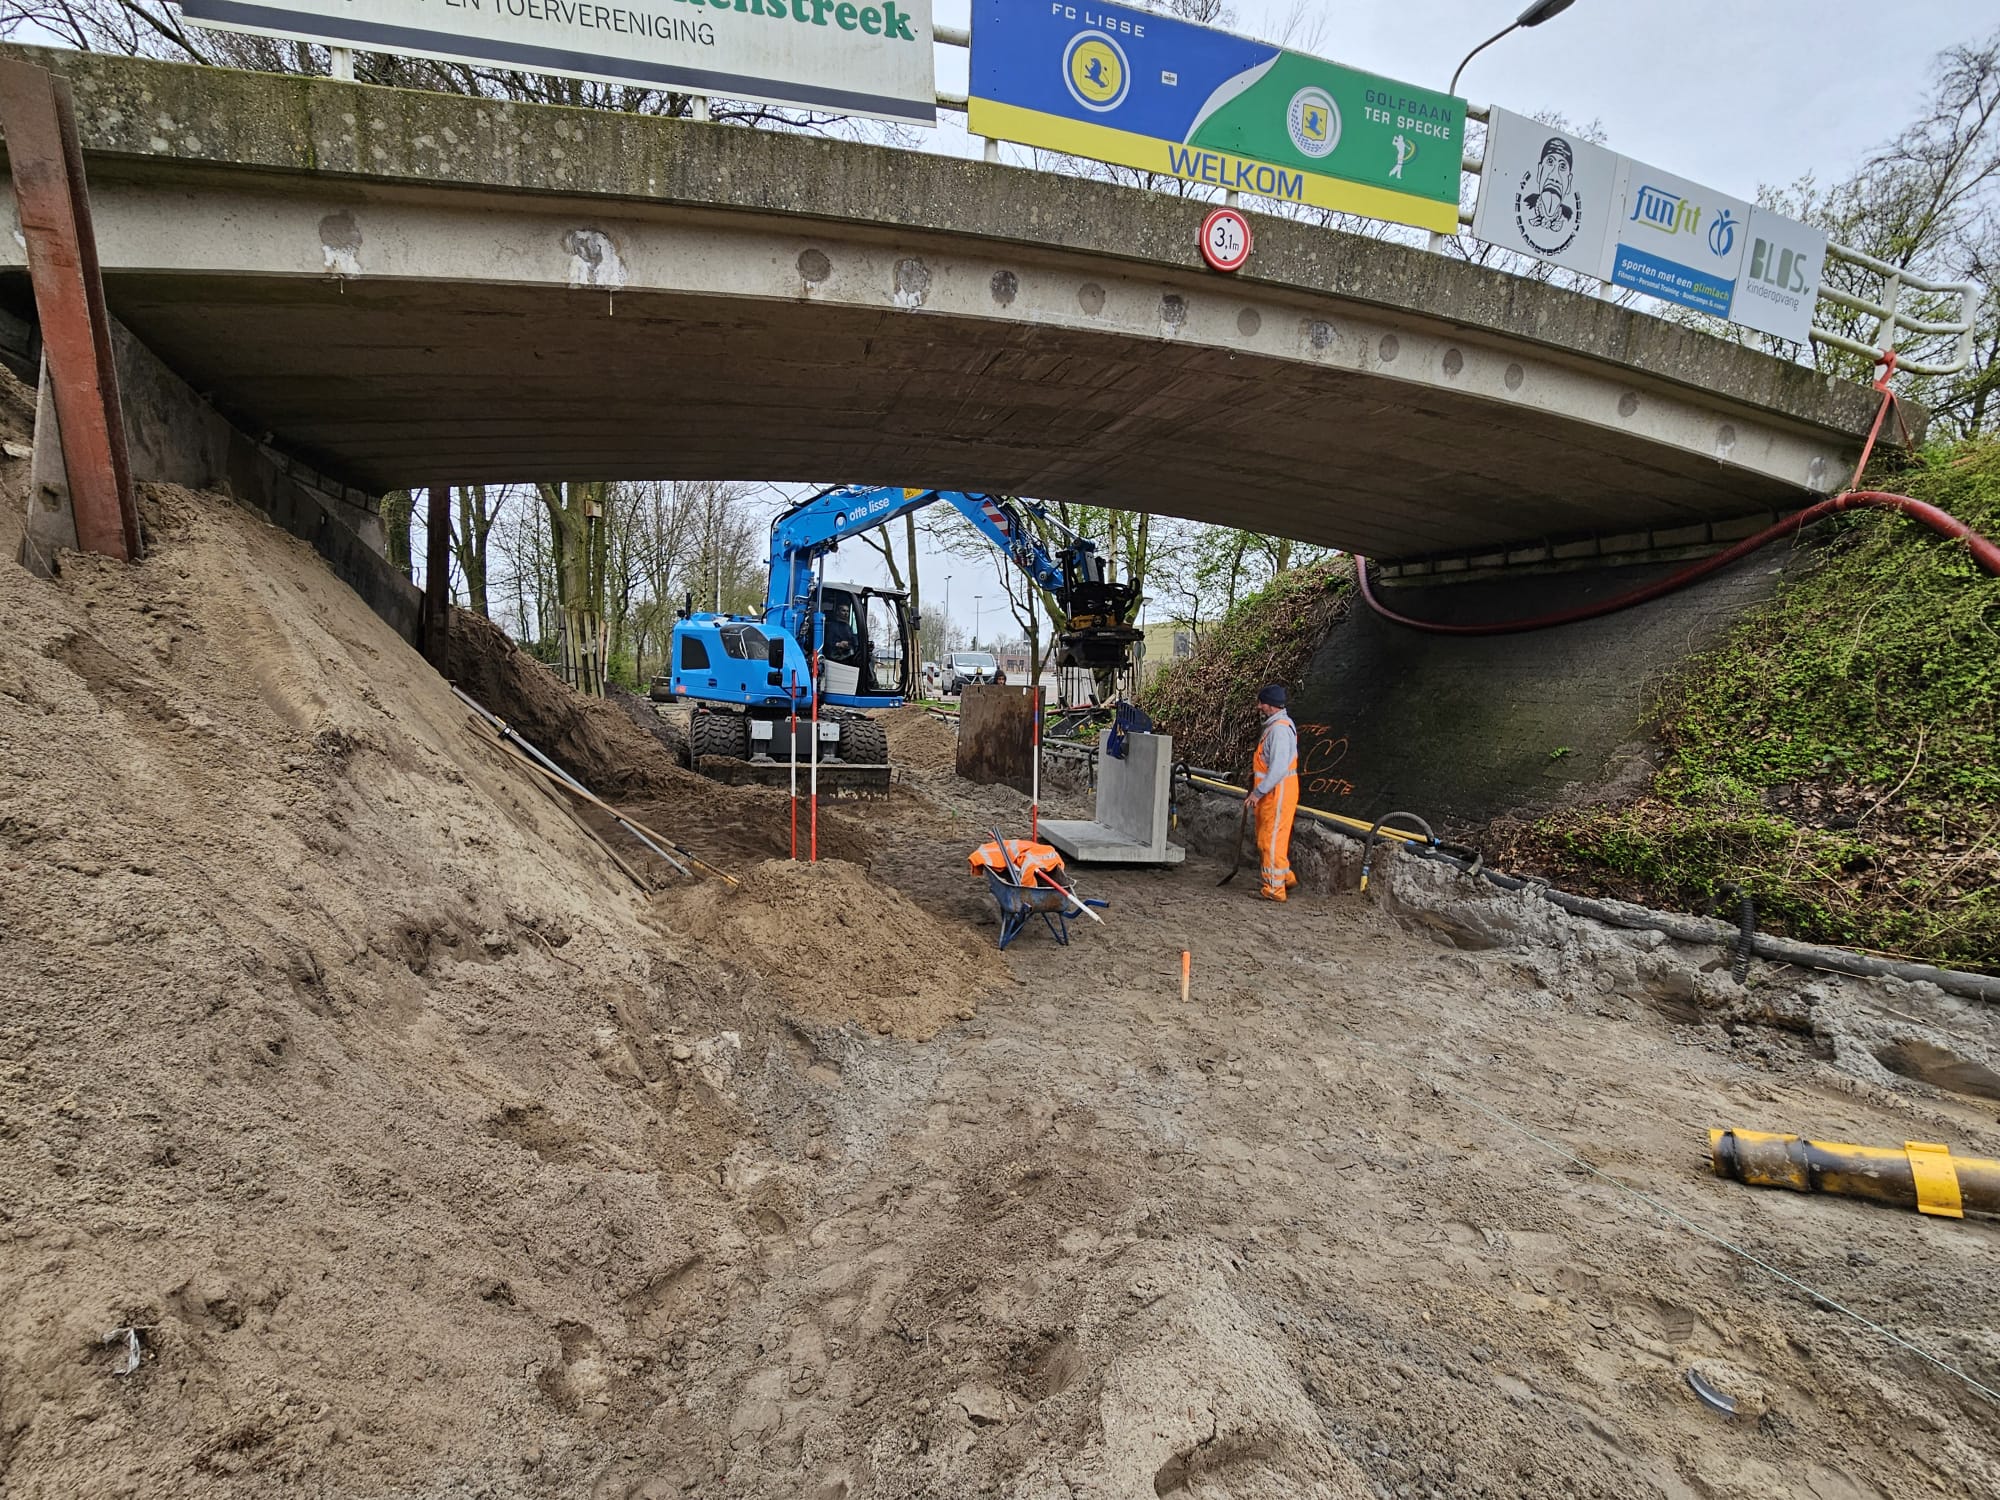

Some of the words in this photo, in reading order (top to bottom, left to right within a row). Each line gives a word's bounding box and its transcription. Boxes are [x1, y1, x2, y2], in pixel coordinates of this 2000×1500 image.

[1052, 3, 1077, 20] FC
[1085, 11, 1145, 38] LISSE
[1365, 89, 1452, 123] GOLFBAAN
[1364, 107, 1391, 125] TER
[1397, 116, 1450, 140] SPECKE
[1168, 145, 1304, 201] WELKOM
[1630, 185, 1702, 235] funfit
[1621, 258, 1657, 278] sporten
[1657, 270, 1675, 283] met
[1676, 276, 1693, 289] een
[1693, 282, 1729, 301] glimlach
[1746, 280, 1800, 312] kinderopvang
[849, 506, 868, 522] otte
[868, 497, 890, 514] lisse
[1308, 778, 1356, 796] OTTE
